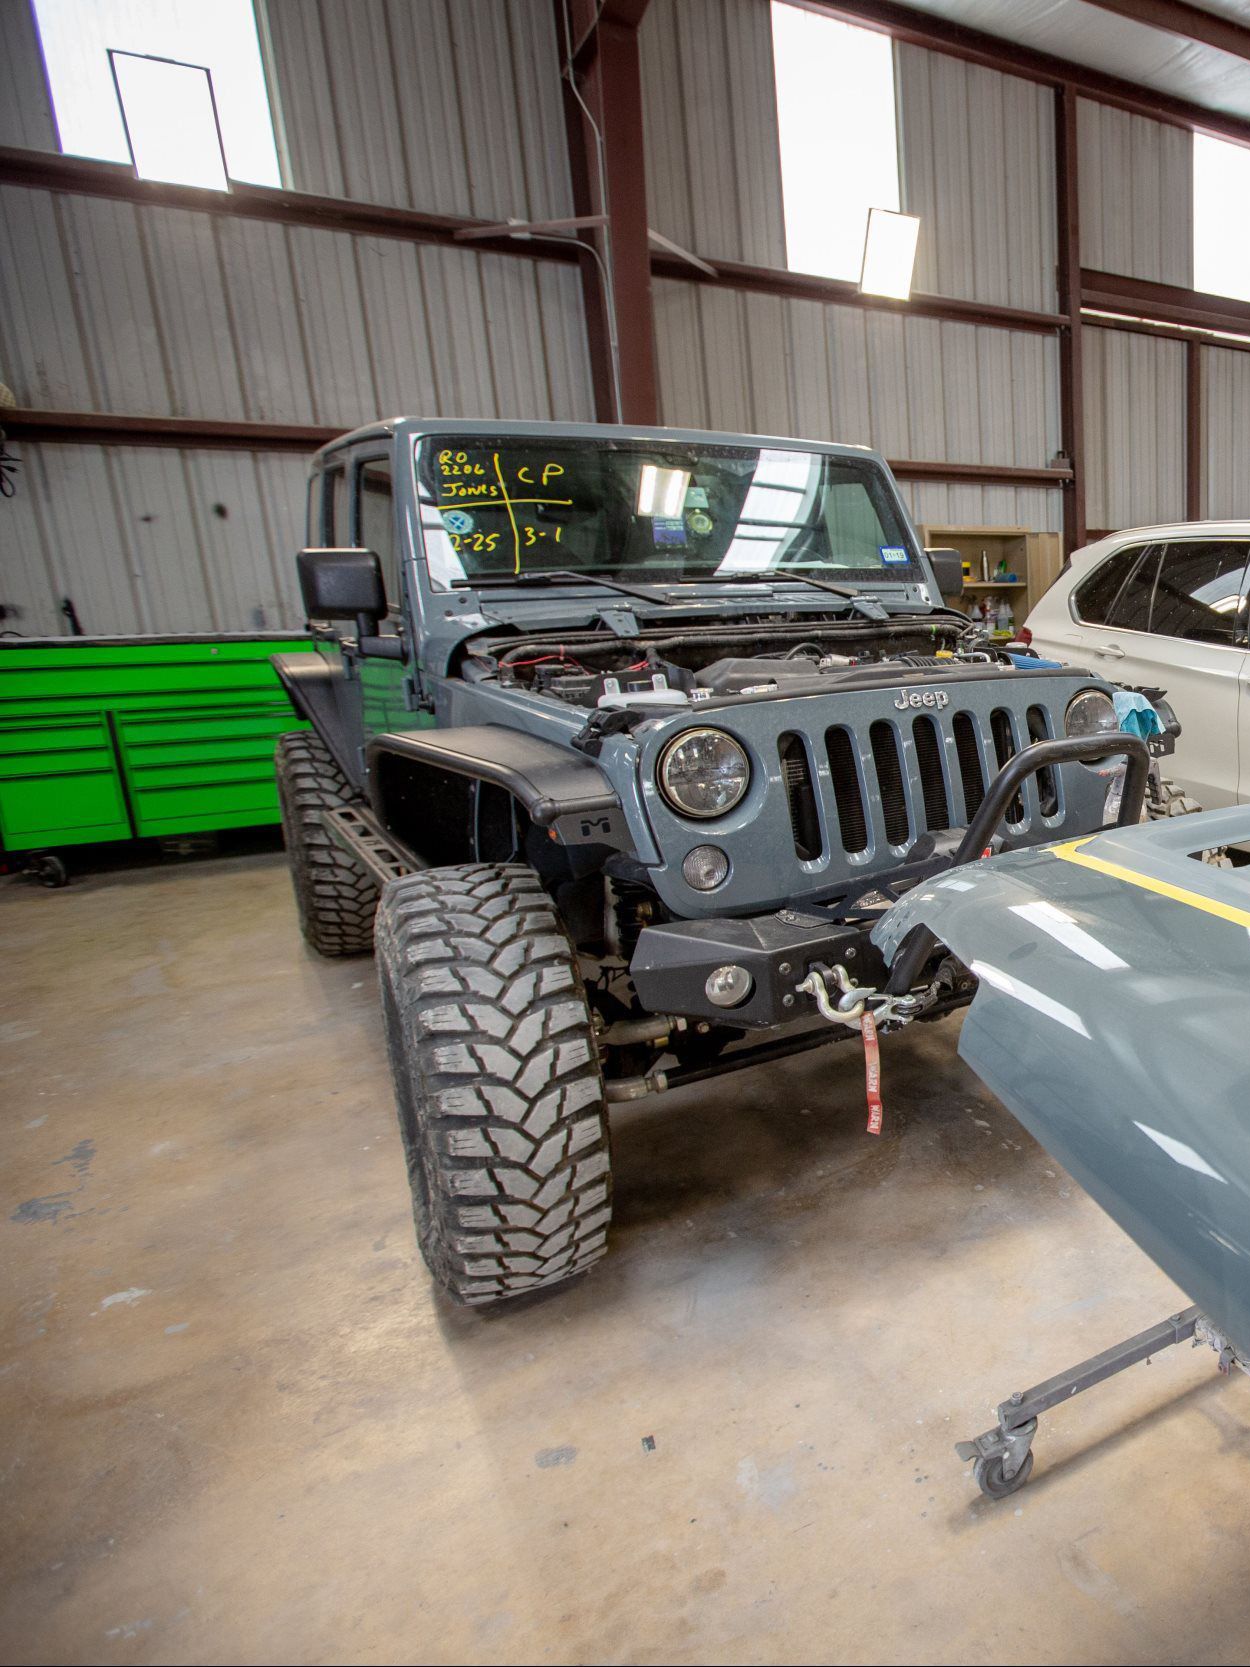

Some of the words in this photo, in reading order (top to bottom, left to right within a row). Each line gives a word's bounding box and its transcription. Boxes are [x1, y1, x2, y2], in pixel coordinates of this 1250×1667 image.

[439, 449, 468, 464] RO
[440, 464, 485, 476] 2206
[894, 689, 949, 710] Jeep
